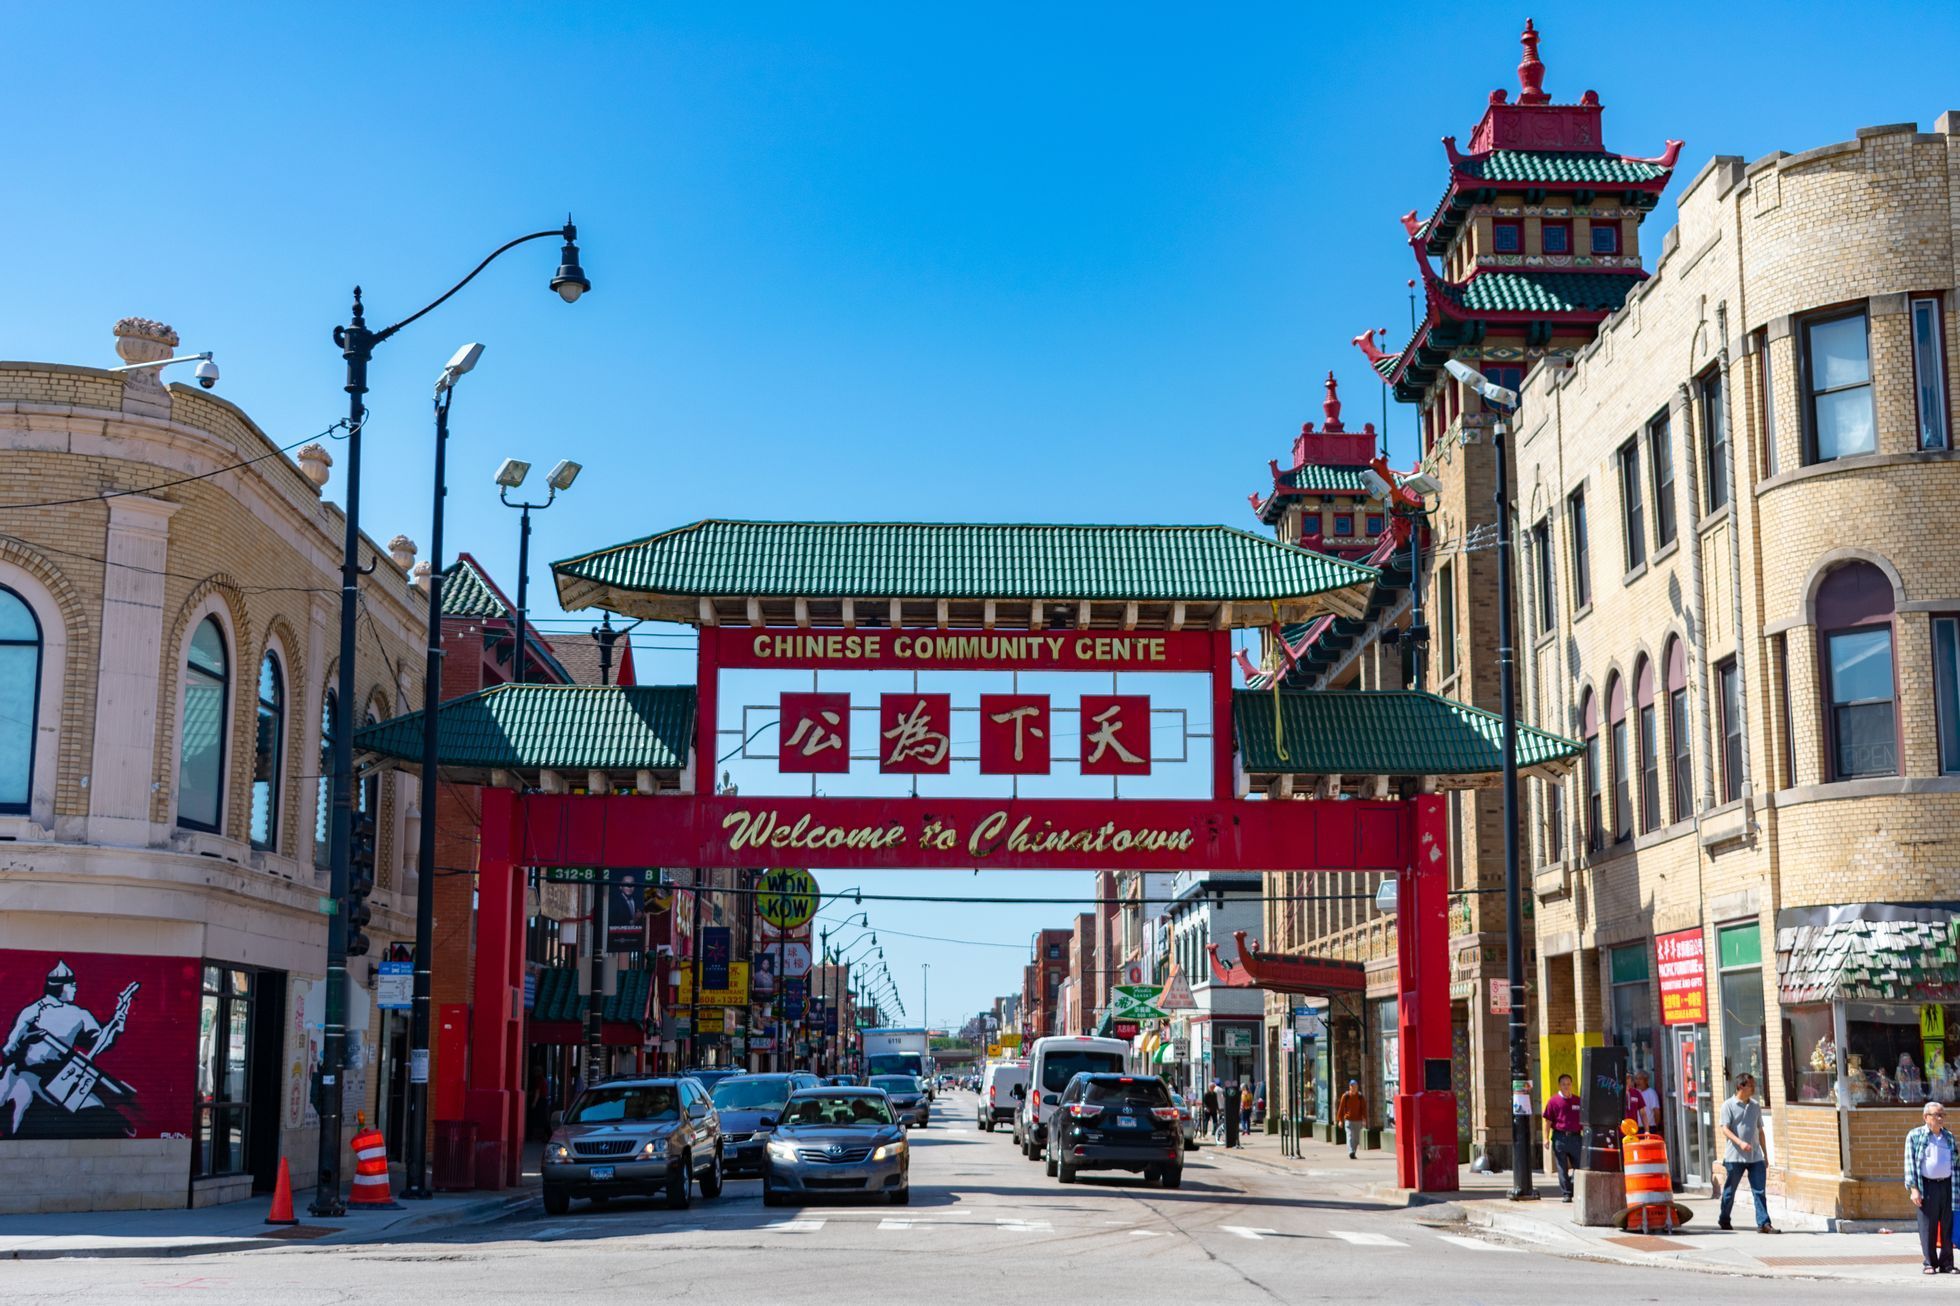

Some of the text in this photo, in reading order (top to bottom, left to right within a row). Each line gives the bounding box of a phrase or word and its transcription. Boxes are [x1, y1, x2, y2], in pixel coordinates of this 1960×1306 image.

[753, 635, 1167, 661] CHINESE COMMUNITY CENTE
[1843, 745, 1896, 770] OPEN
[722, 810, 1195, 857] Welcome to Chinatown
[767, 875, 808, 894] WON
[767, 899, 809, 918] KOW
